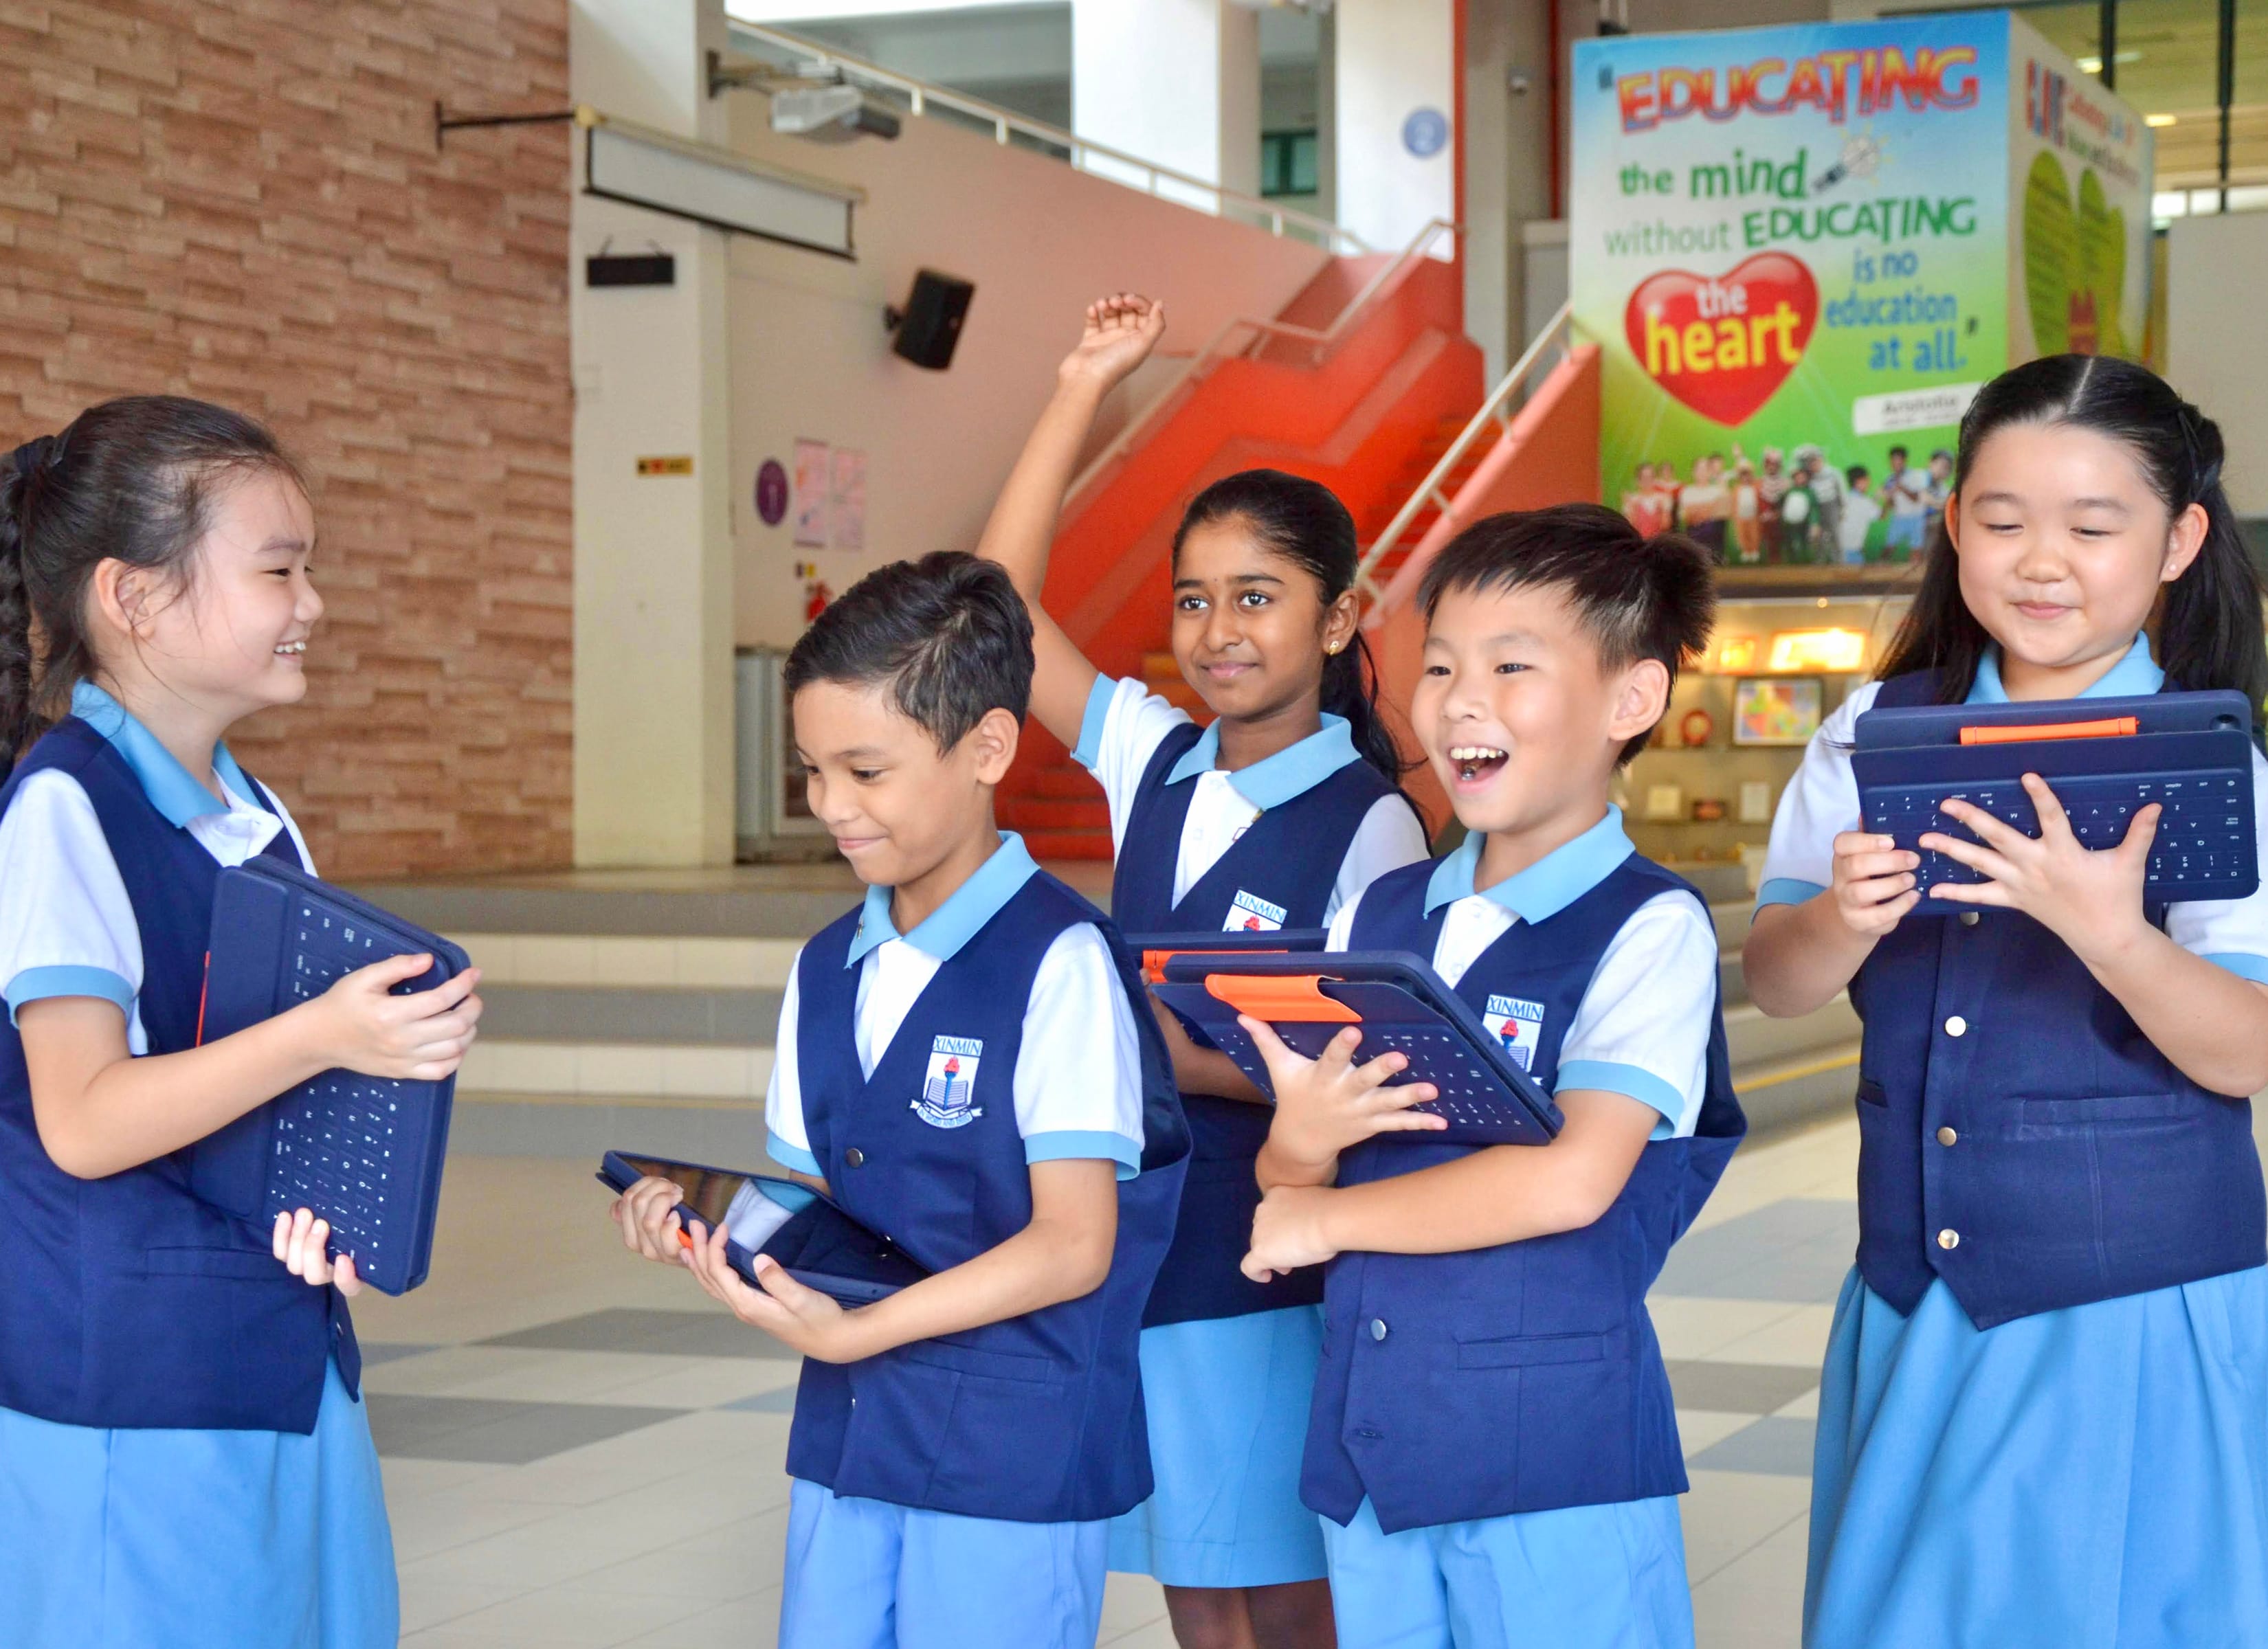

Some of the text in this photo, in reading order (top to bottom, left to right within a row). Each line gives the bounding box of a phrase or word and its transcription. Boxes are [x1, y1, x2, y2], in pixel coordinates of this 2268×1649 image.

[1619, 147, 1810, 199] the mind
[1603, 198, 1977, 255] without EDUCATING
[1853, 248, 1917, 284] is no
[1695, 280, 1747, 318] the
[1825, 285, 1958, 328] education
[1646, 300, 1801, 376] heart
[1868, 334, 1901, 370] at
[1235, 893, 1286, 921] XINMIN
[1487, 997, 1542, 1019] XINMIN
[933, 1037, 981, 1055] XINMIN
